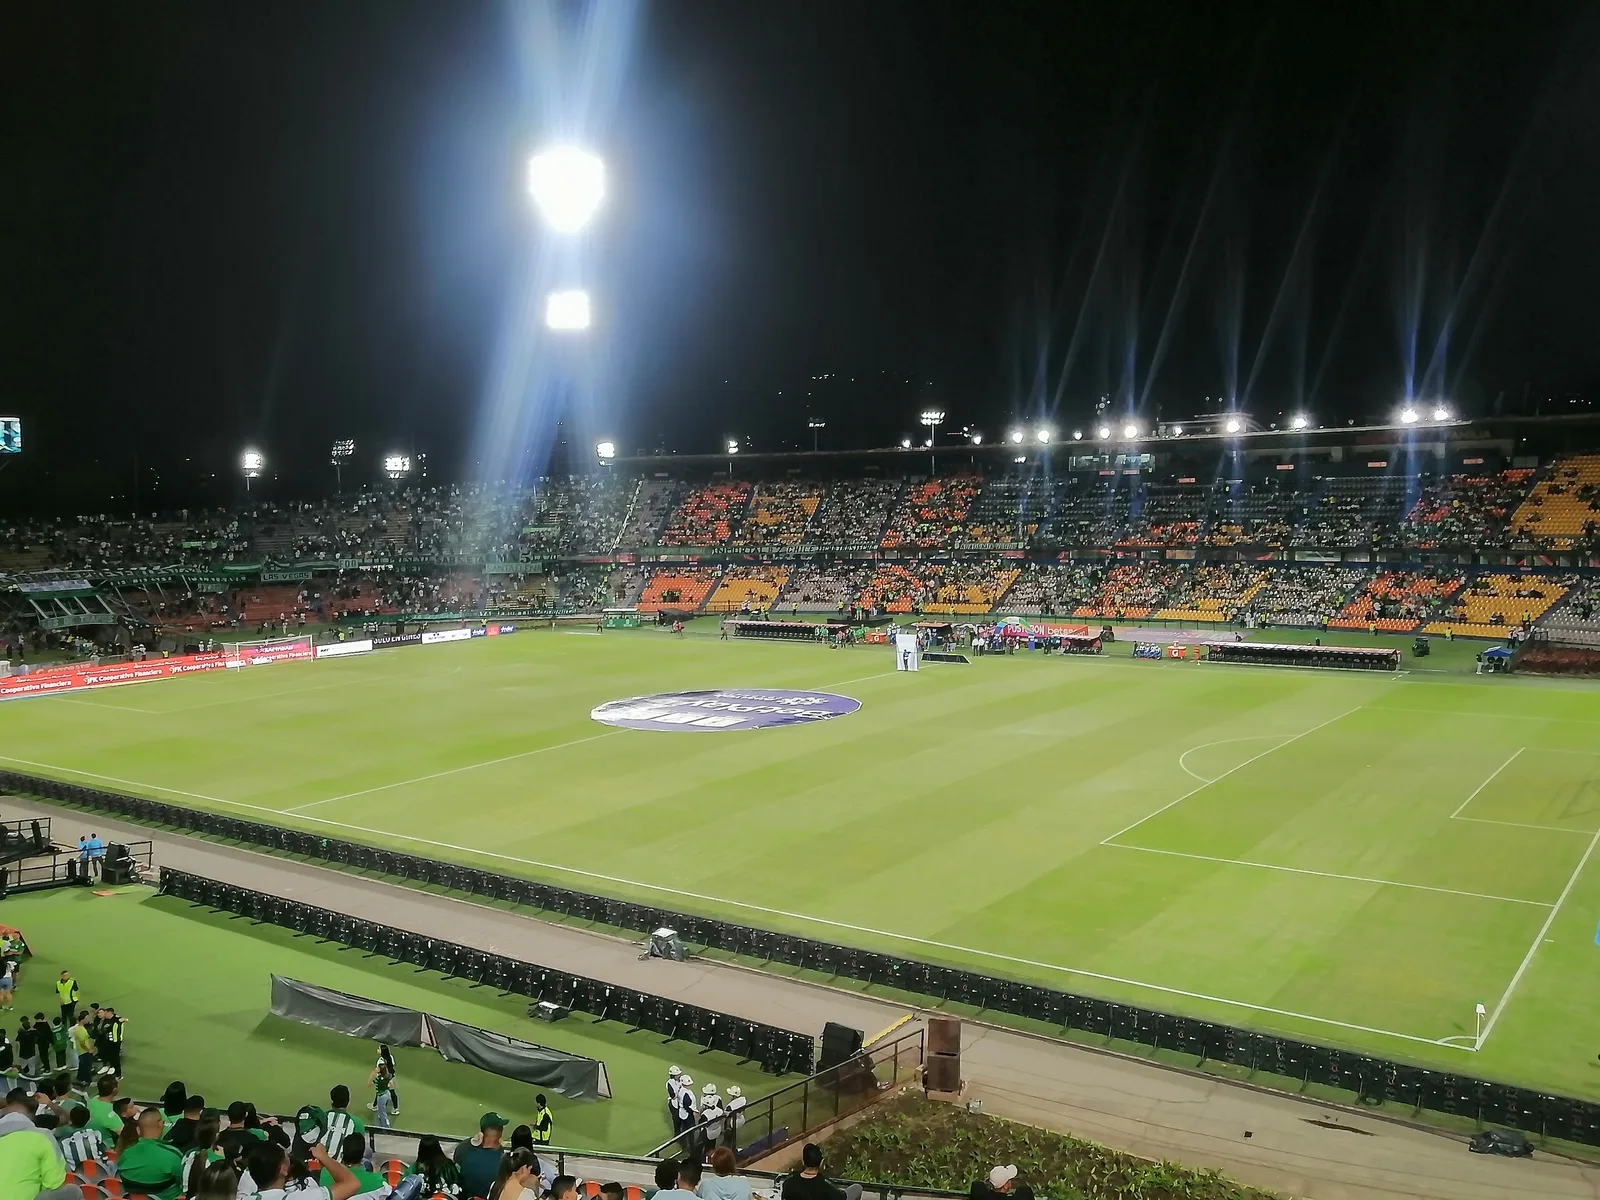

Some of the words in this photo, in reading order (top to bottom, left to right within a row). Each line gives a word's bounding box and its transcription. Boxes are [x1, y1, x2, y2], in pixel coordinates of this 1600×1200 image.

[263, 573, 279, 581] LAS
[282, 572, 309, 580] VEGAS
[1008, 624, 1045, 635] POSTBON
[99, 672, 134, 682] Cooperativa
[135, 669, 163, 677] Financiera
[0, 684, 40, 693] Cooperativa
[40, 680, 72, 689] Financiera
